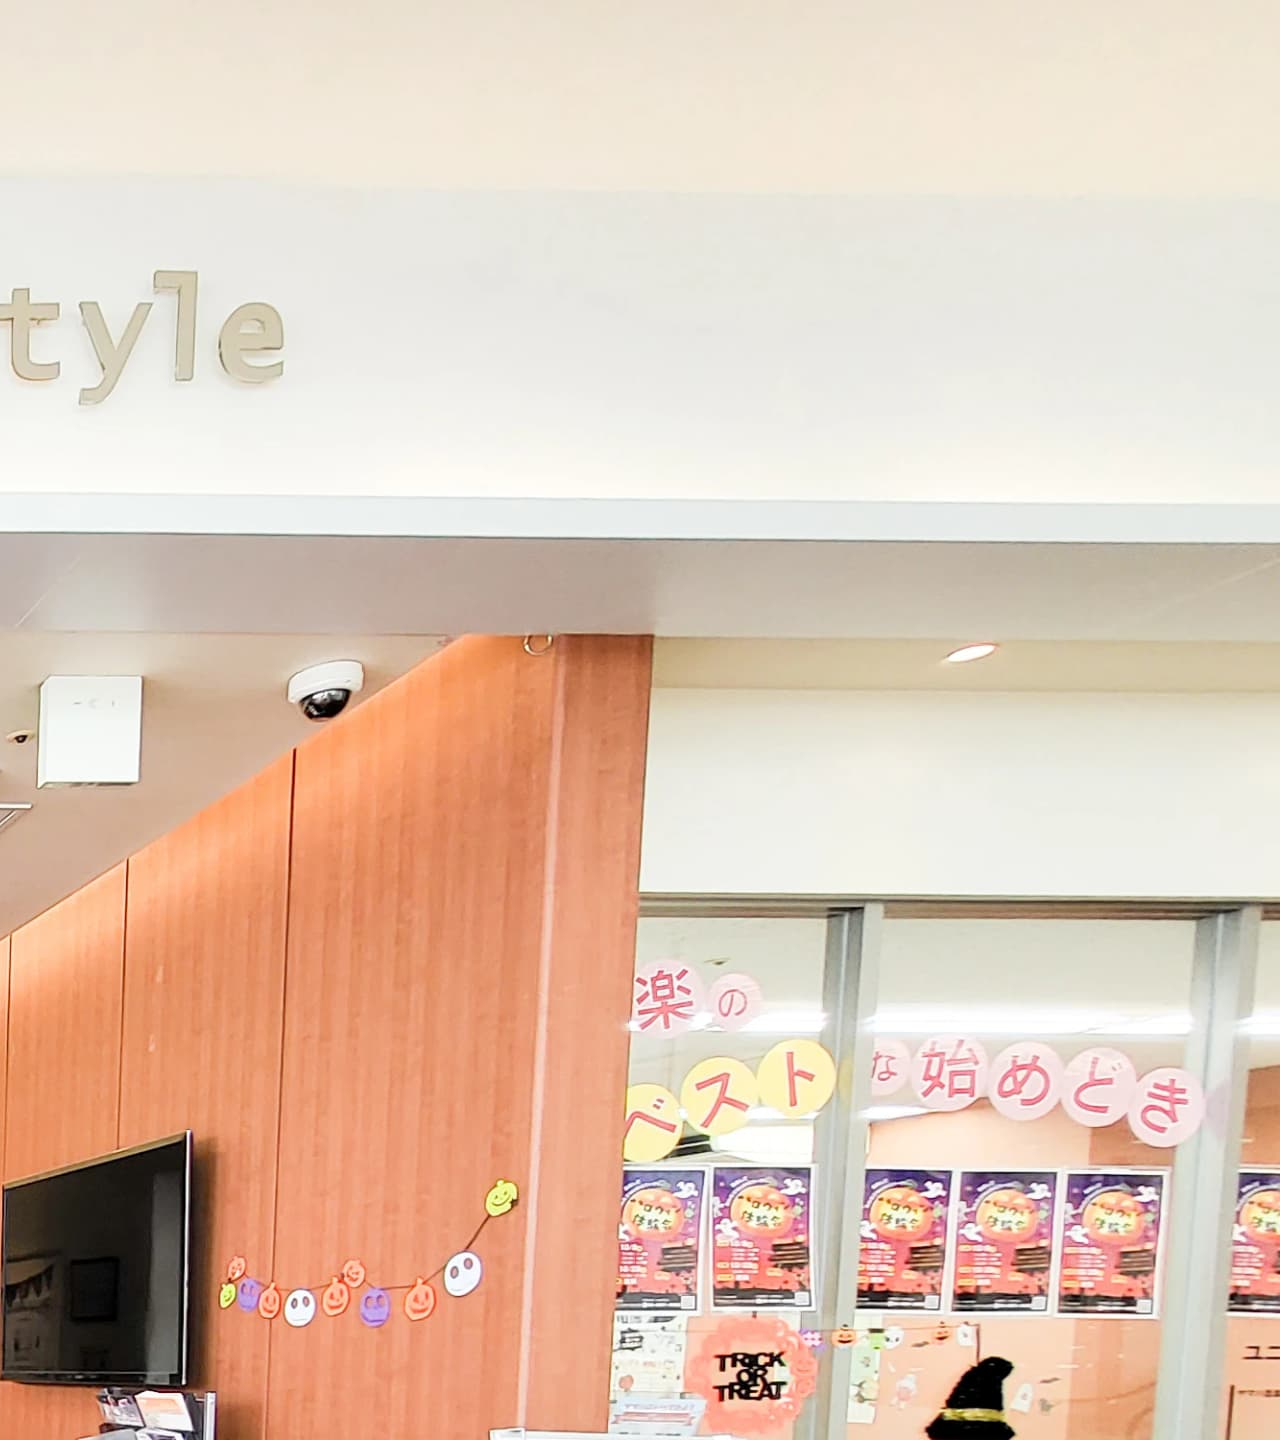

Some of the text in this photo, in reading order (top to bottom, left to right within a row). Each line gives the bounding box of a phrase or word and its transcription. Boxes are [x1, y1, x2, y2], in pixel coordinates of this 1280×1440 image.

[714, 1352, 786, 1372] TRICK
[737, 1368, 768, 1385] OR
[713, 1381, 788, 1402] TREAT
